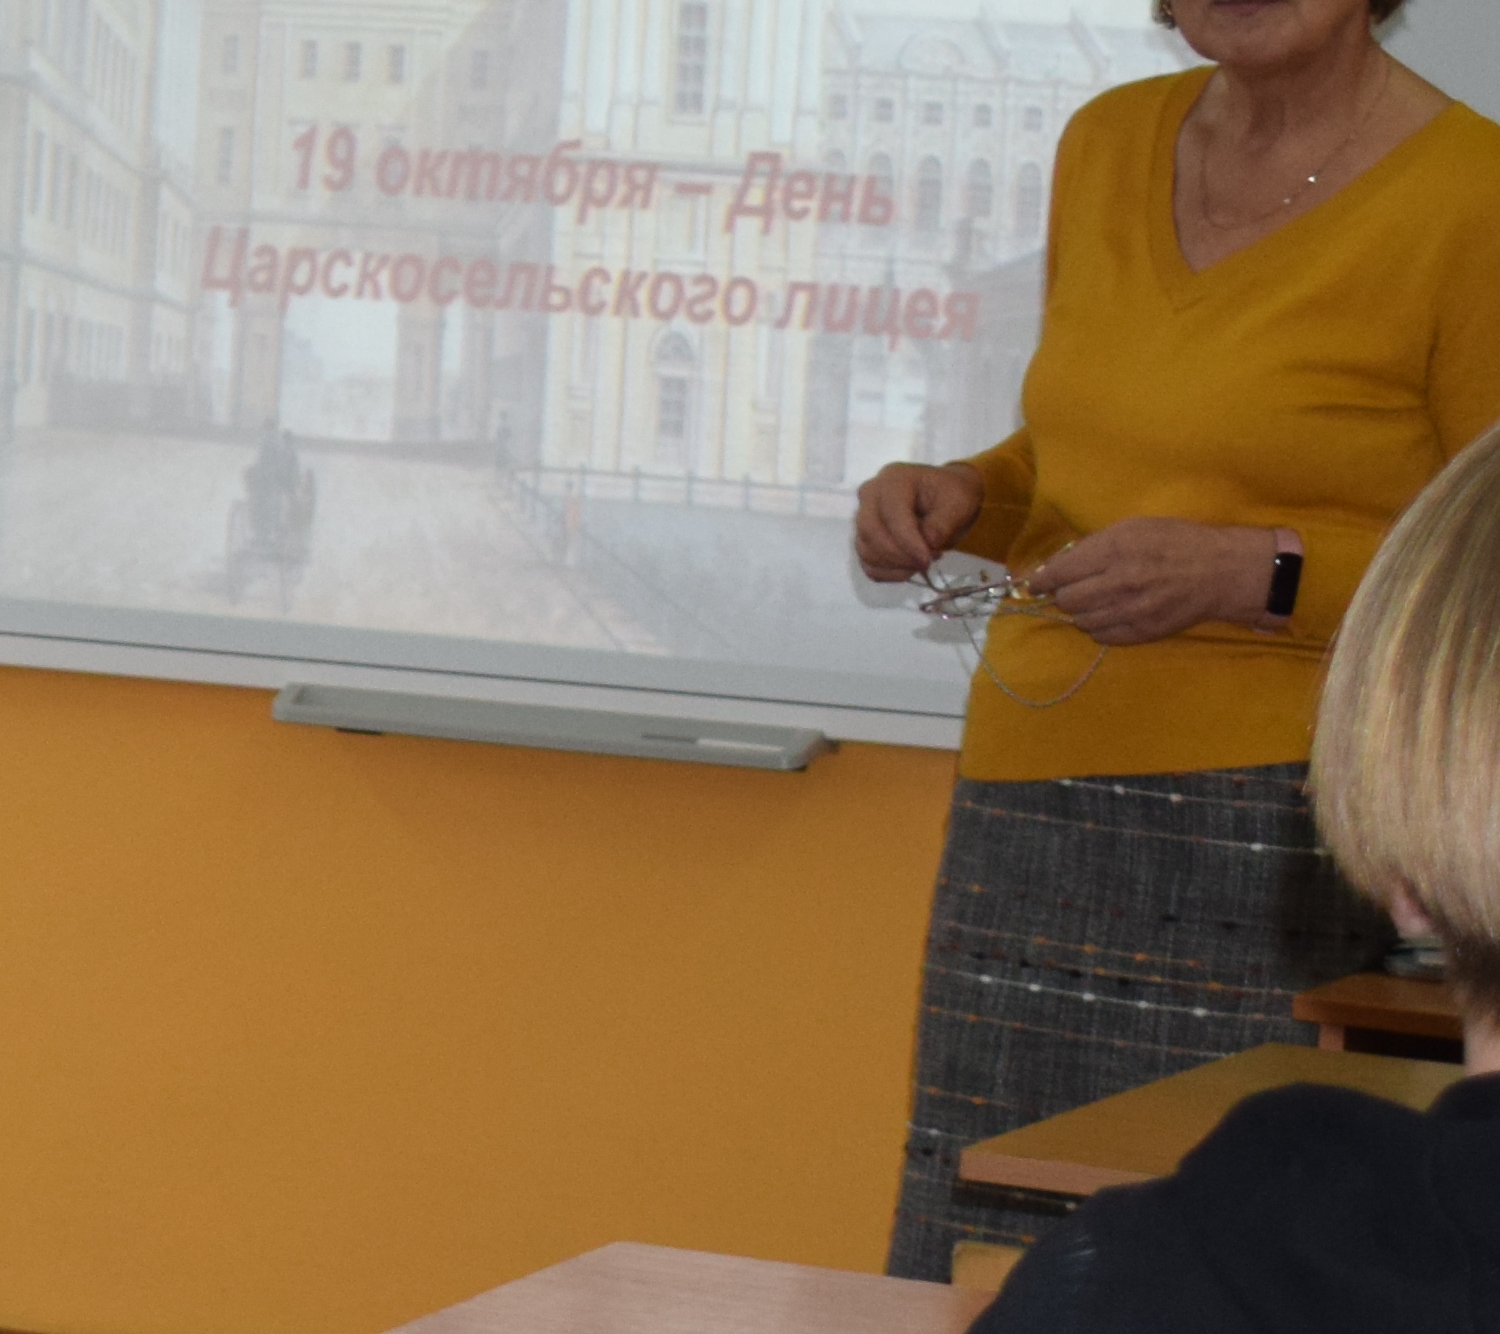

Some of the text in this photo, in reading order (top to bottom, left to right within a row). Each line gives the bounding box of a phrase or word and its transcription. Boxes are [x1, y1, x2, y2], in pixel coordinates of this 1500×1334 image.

[290, 124, 361, 194] 19
[374, 137, 659, 214] октября
[725, 150, 895, 230] День
[200, 225, 980, 343] Царскосельского лицея
